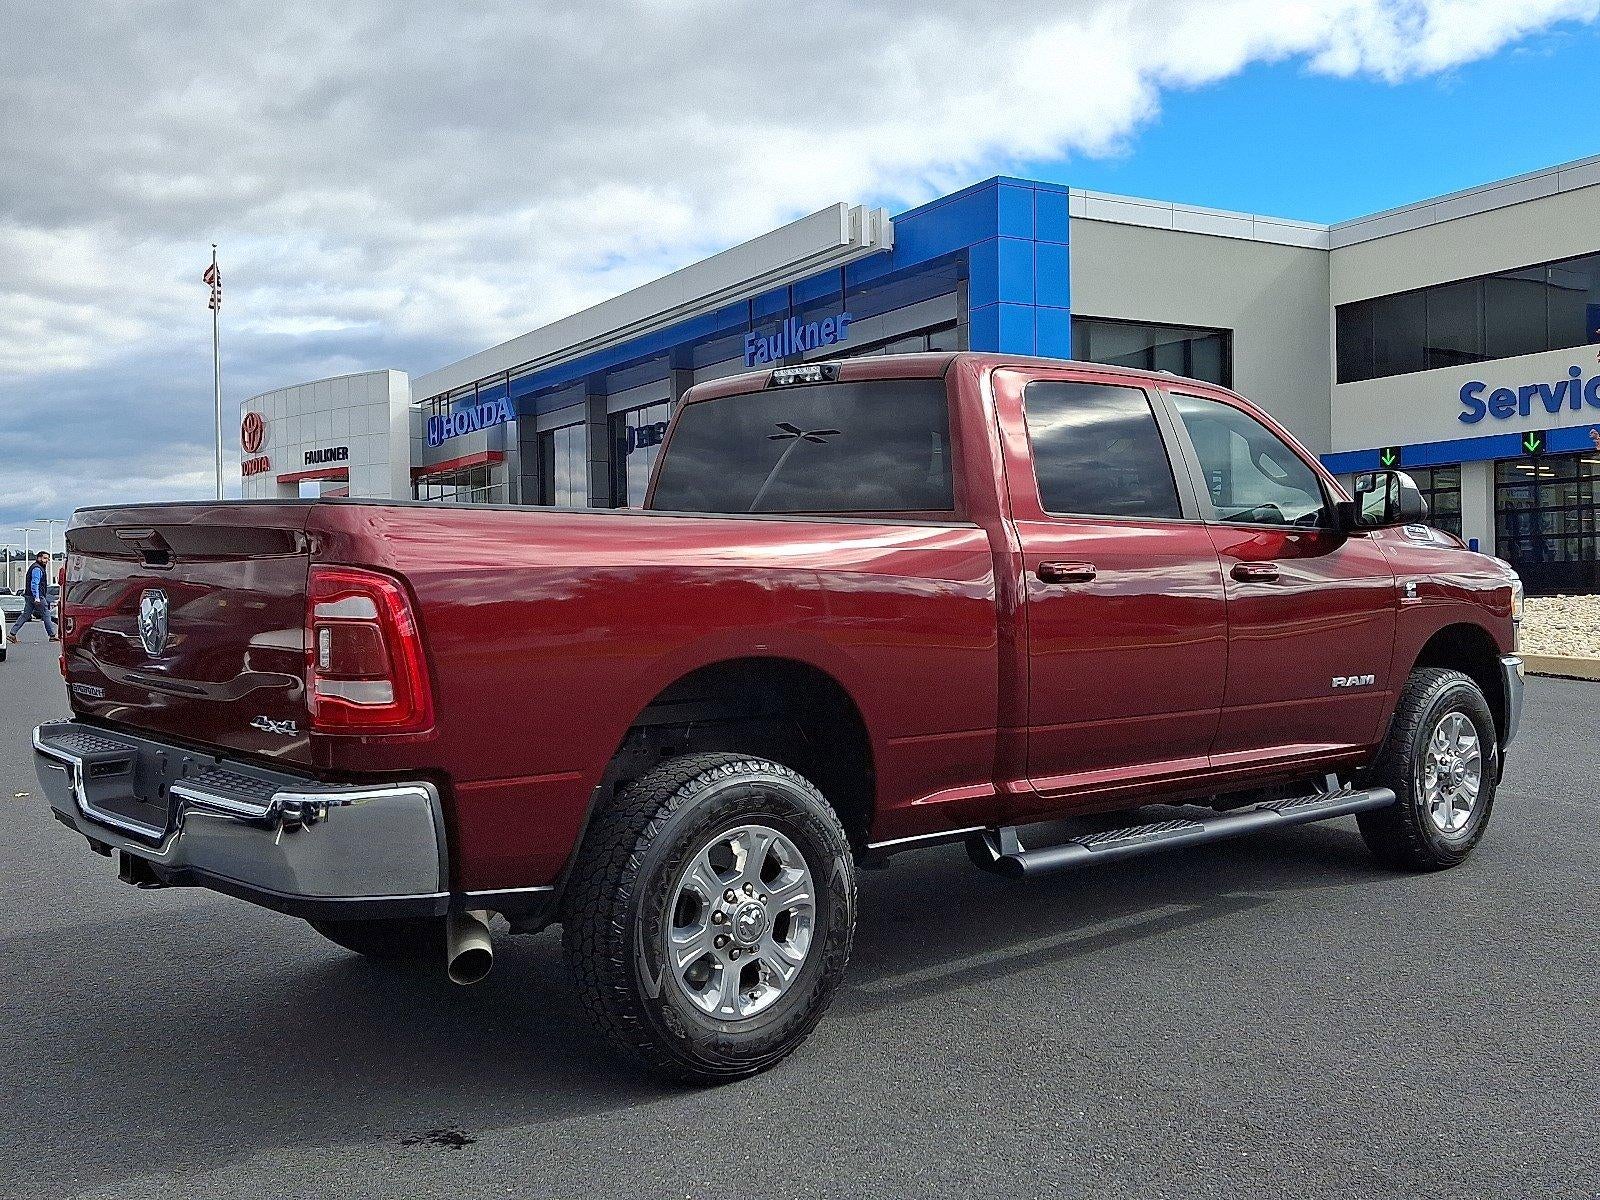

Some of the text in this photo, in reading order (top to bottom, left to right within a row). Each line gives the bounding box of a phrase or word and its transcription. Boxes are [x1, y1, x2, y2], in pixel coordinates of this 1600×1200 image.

[744, 311, 852, 367] Faulkner
[441, 396, 516, 440] HONDA
[304, 446, 349, 465] FAULKNER
[1331, 674, 1375, 688] RAM
